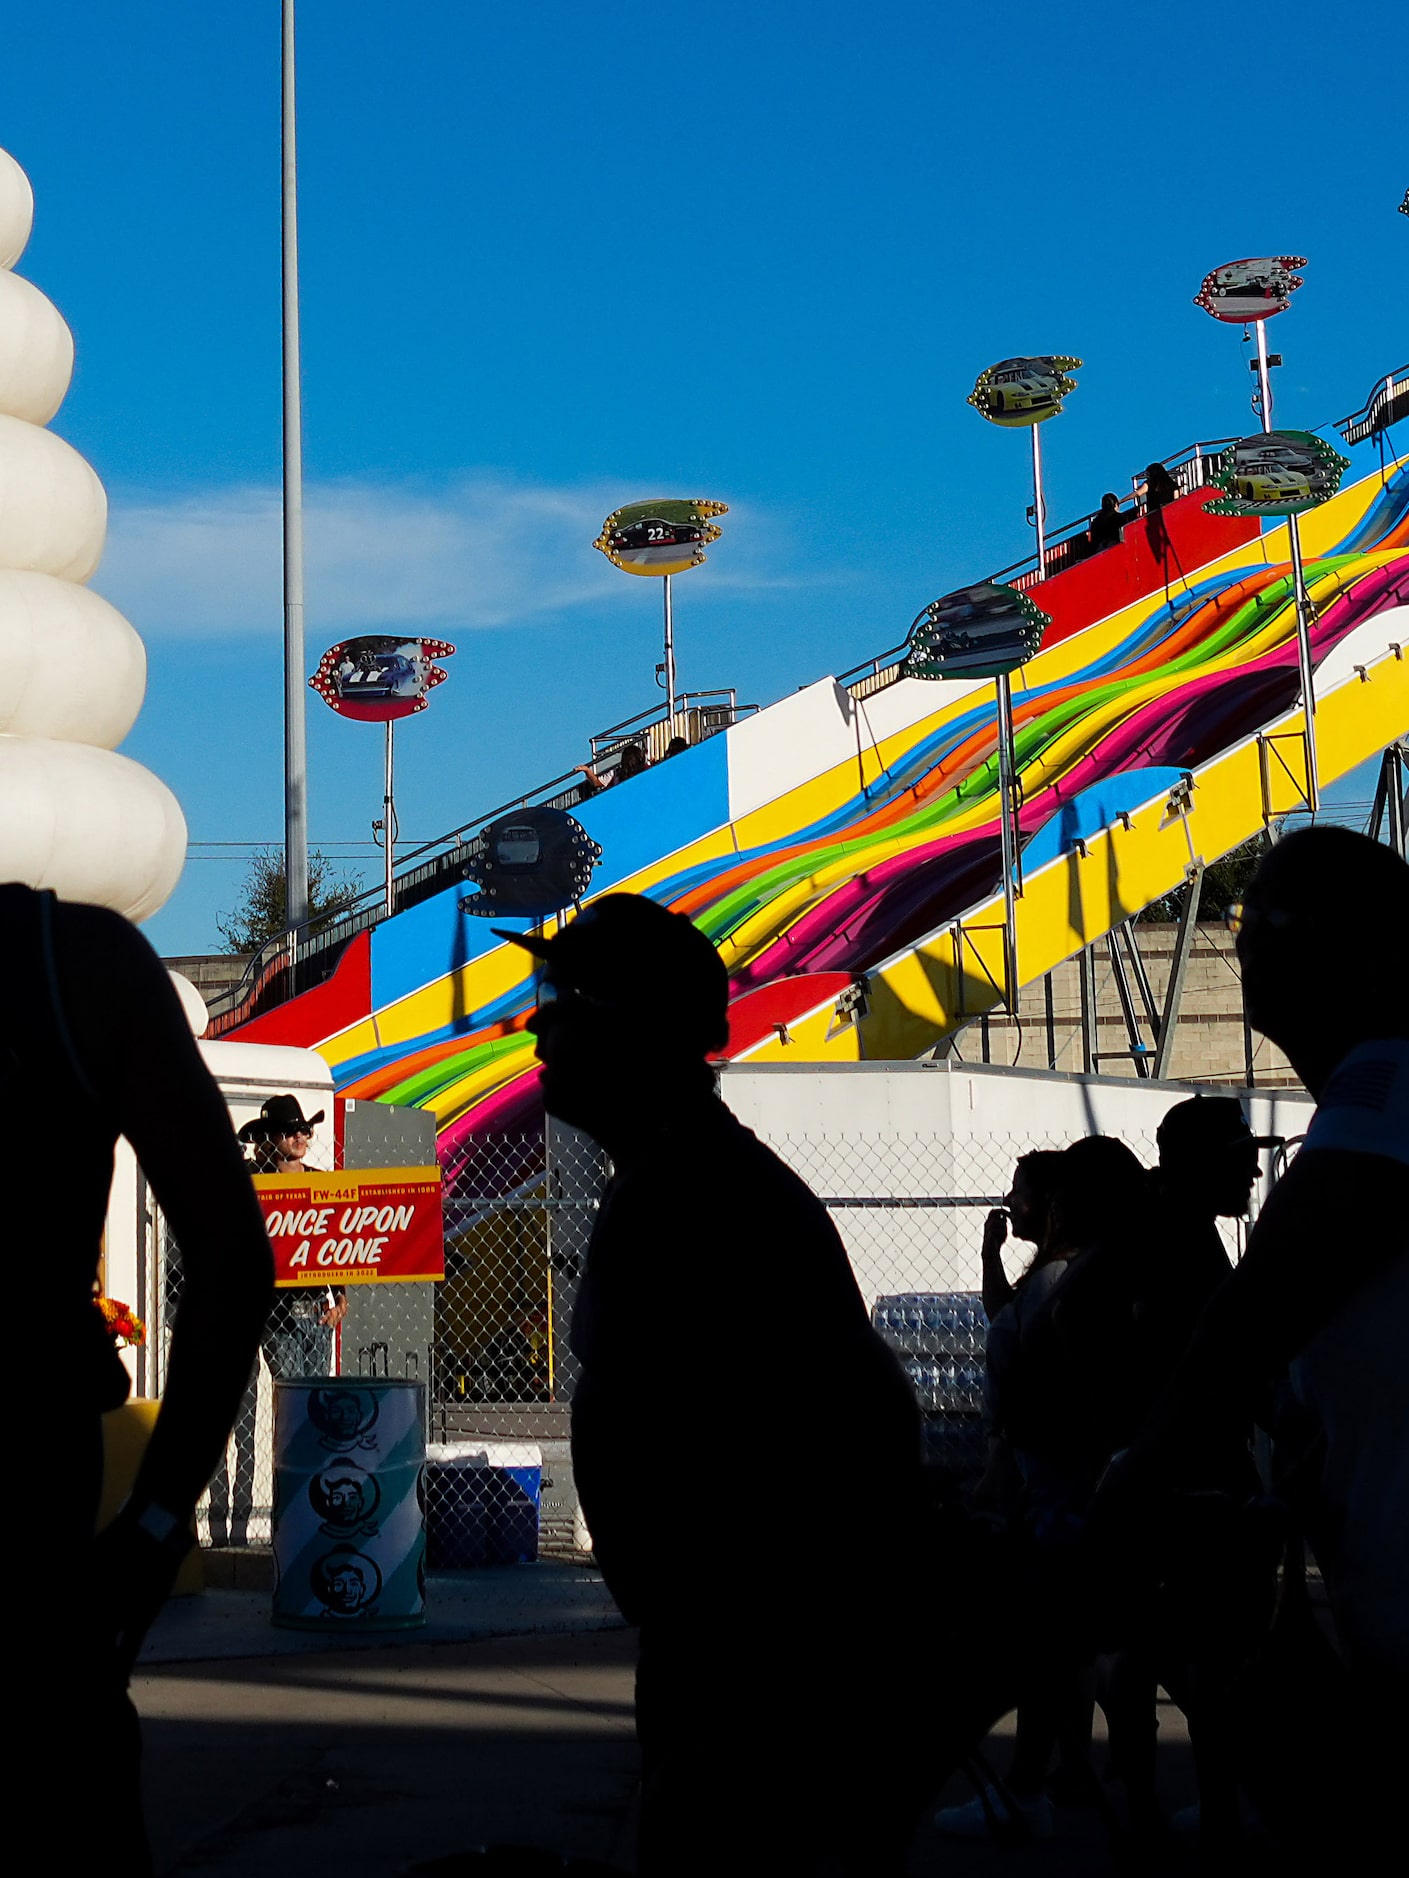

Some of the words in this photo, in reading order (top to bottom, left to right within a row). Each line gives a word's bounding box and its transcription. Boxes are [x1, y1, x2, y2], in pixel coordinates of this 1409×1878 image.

[647, 528, 665, 541] 22
[286, 1192, 306, 1200] TEXAS
[313, 1188, 357, 1200] FW-44F
[361, 1187, 405, 1196] ESTABLISHED
[408, 1186, 415, 1194] IN
[265, 1208, 335, 1237] ONCE
[339, 1205, 415, 1234] UPON
[289, 1239, 310, 1267] A
[317, 1236, 389, 1266] CONE
[300, 1271, 344, 1279] INTRODUCED
